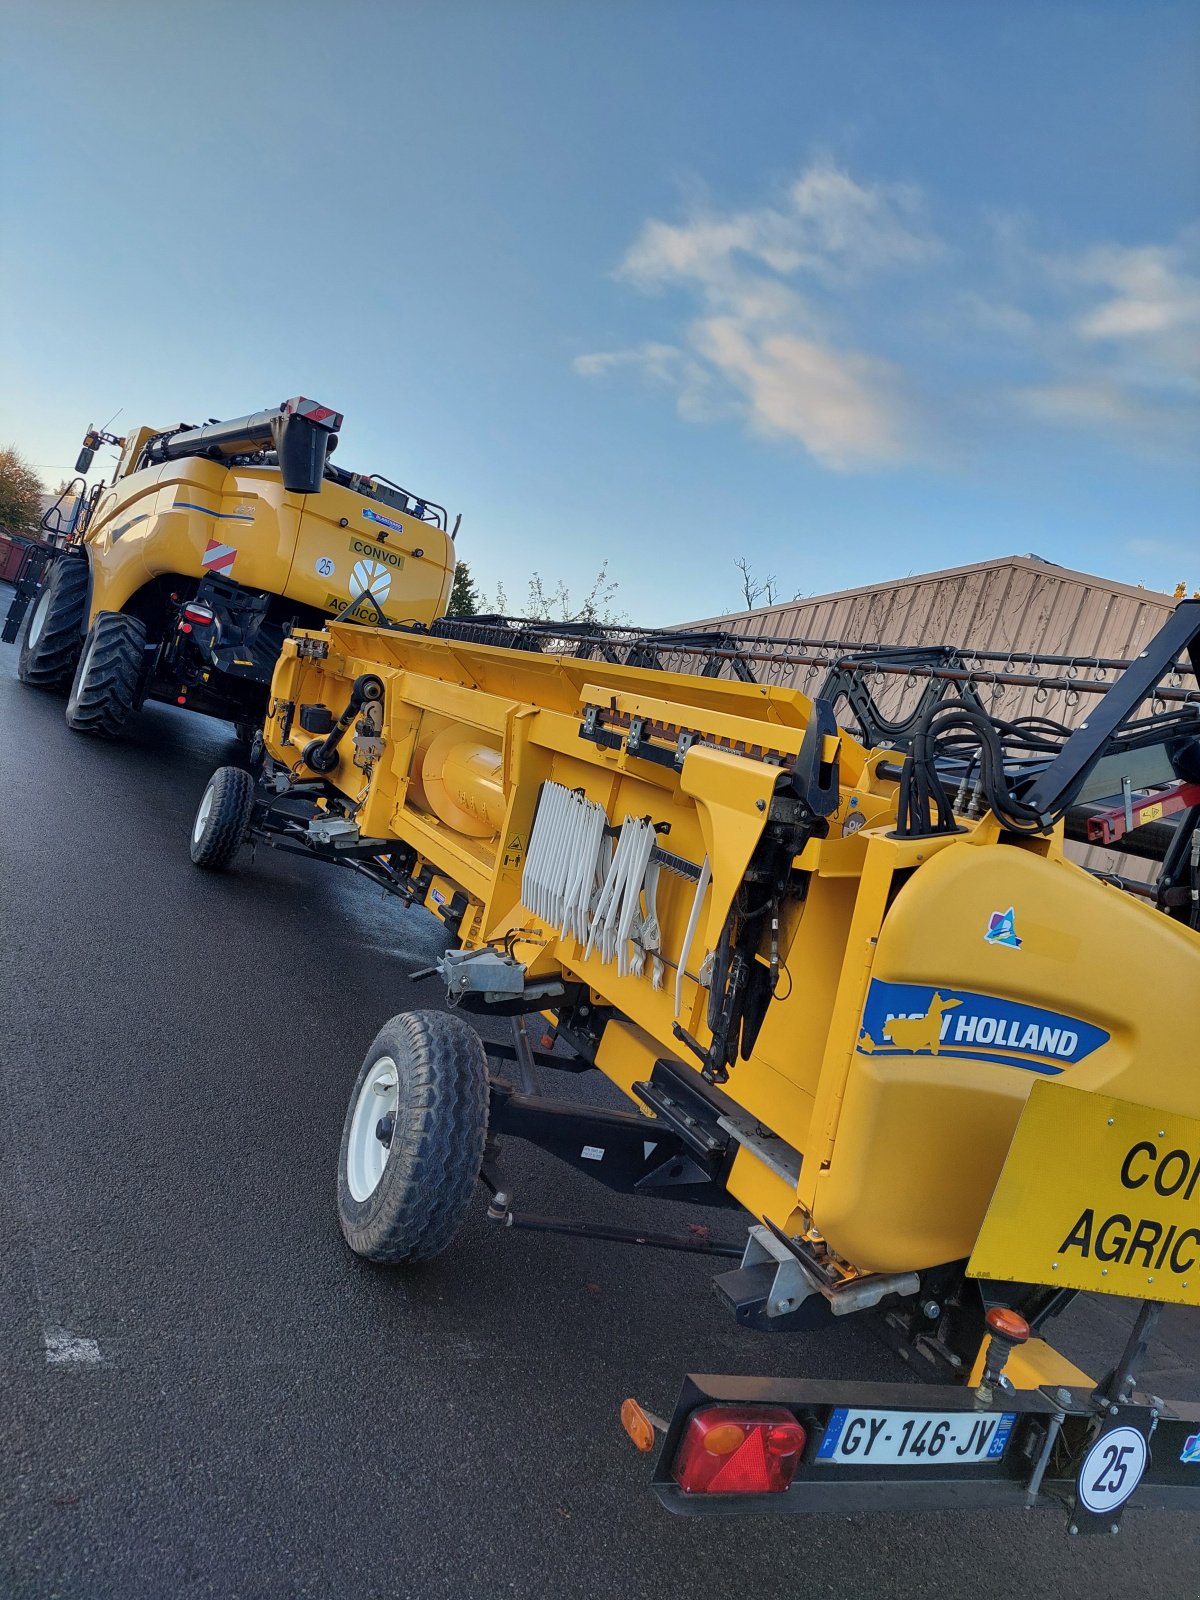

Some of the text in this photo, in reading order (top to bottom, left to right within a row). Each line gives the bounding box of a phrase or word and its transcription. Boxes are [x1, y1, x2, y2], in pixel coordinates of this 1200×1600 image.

[318, 558, 331, 576] 25
[354, 541, 401, 567] CONVOI
[329, 598, 394, 625] AGICO
[955, 1015, 1078, 1057] HOLLAND
[1057, 1208, 1200, 1274] AGRIC
[823, 1438, 832, 1449] F
[841, 1417, 996, 1457] GY-146-JV
[989, 1437, 1006, 1454] 35
[1091, 1444, 1135, 1493] 25
